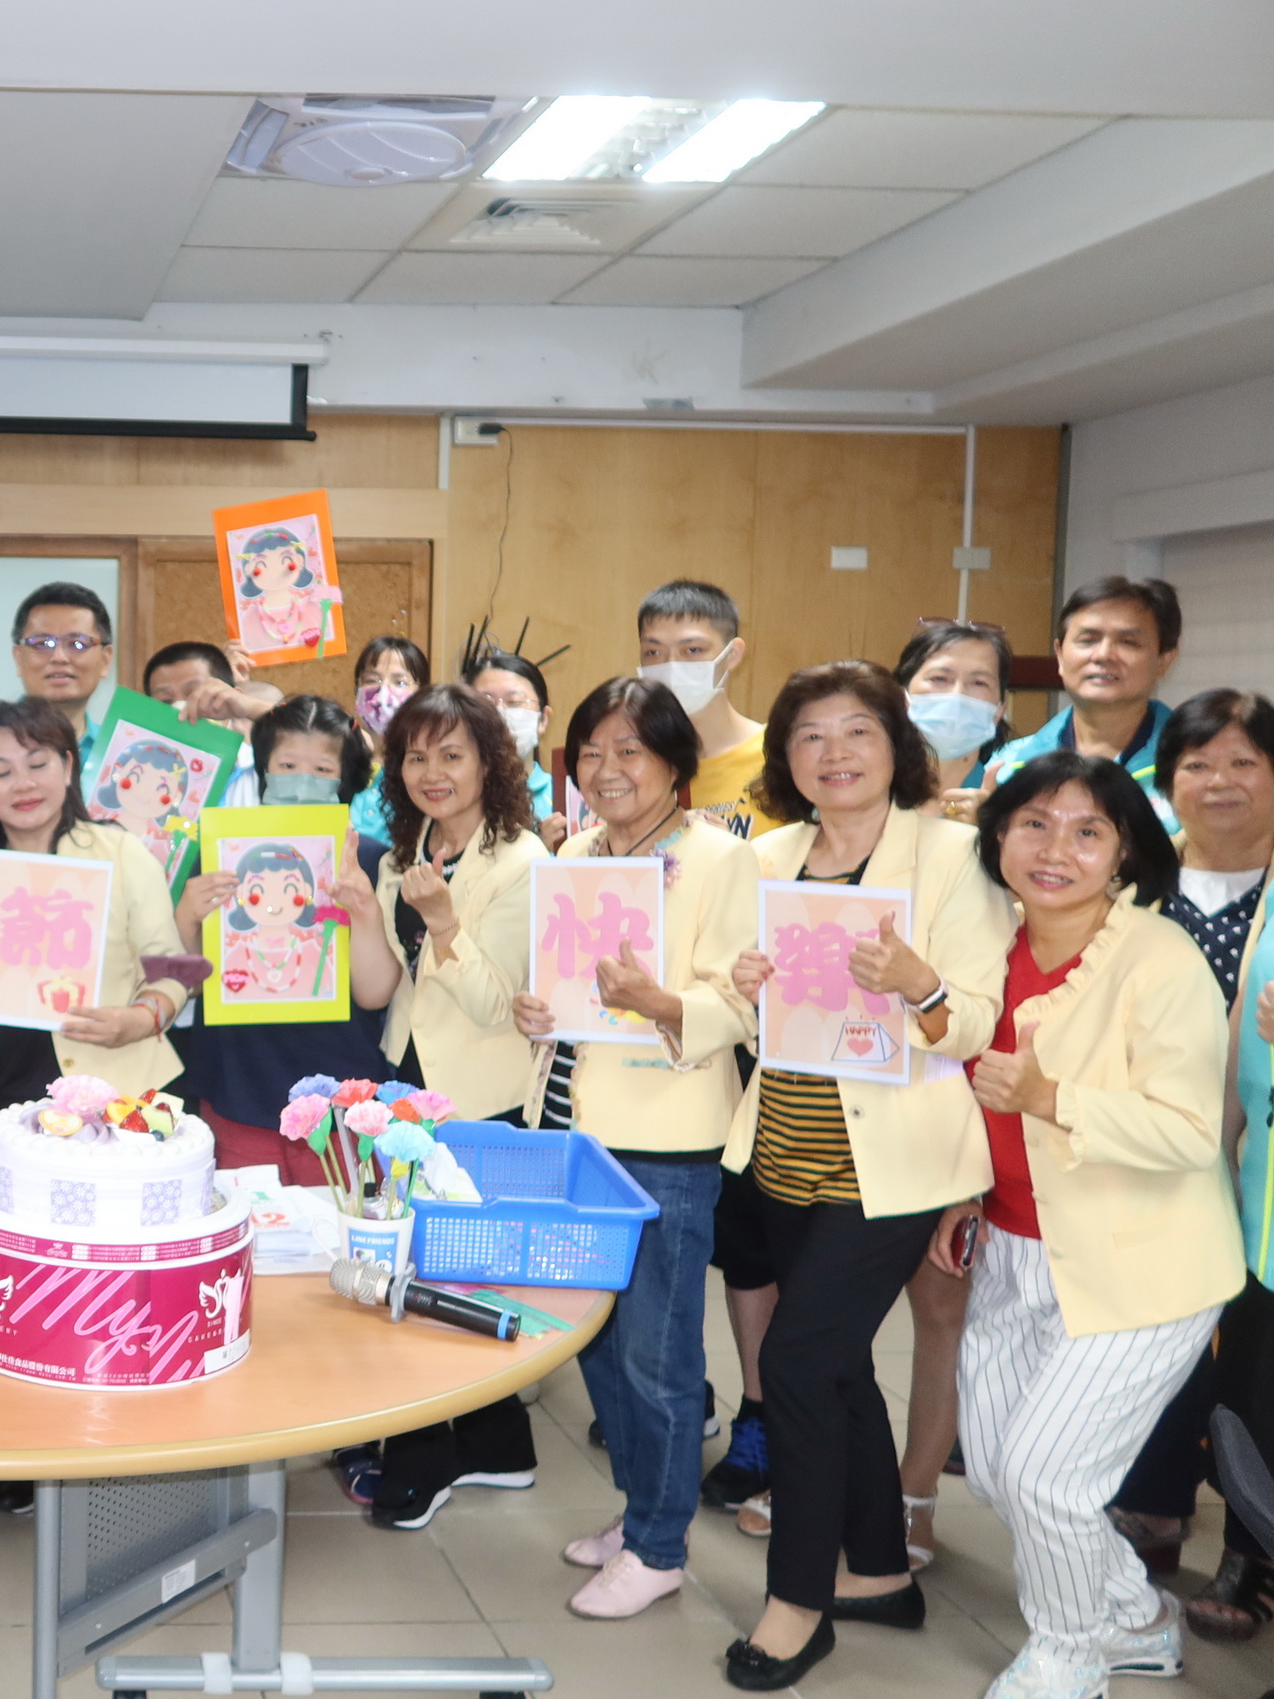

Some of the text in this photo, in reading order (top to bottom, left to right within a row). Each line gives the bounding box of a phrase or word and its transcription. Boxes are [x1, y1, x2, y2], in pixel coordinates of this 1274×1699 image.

[541, 891, 654, 979] 快
[845, 1026, 877, 1036] HAPPY
[351, 1235, 395, 1245] LINE FRIENDS
